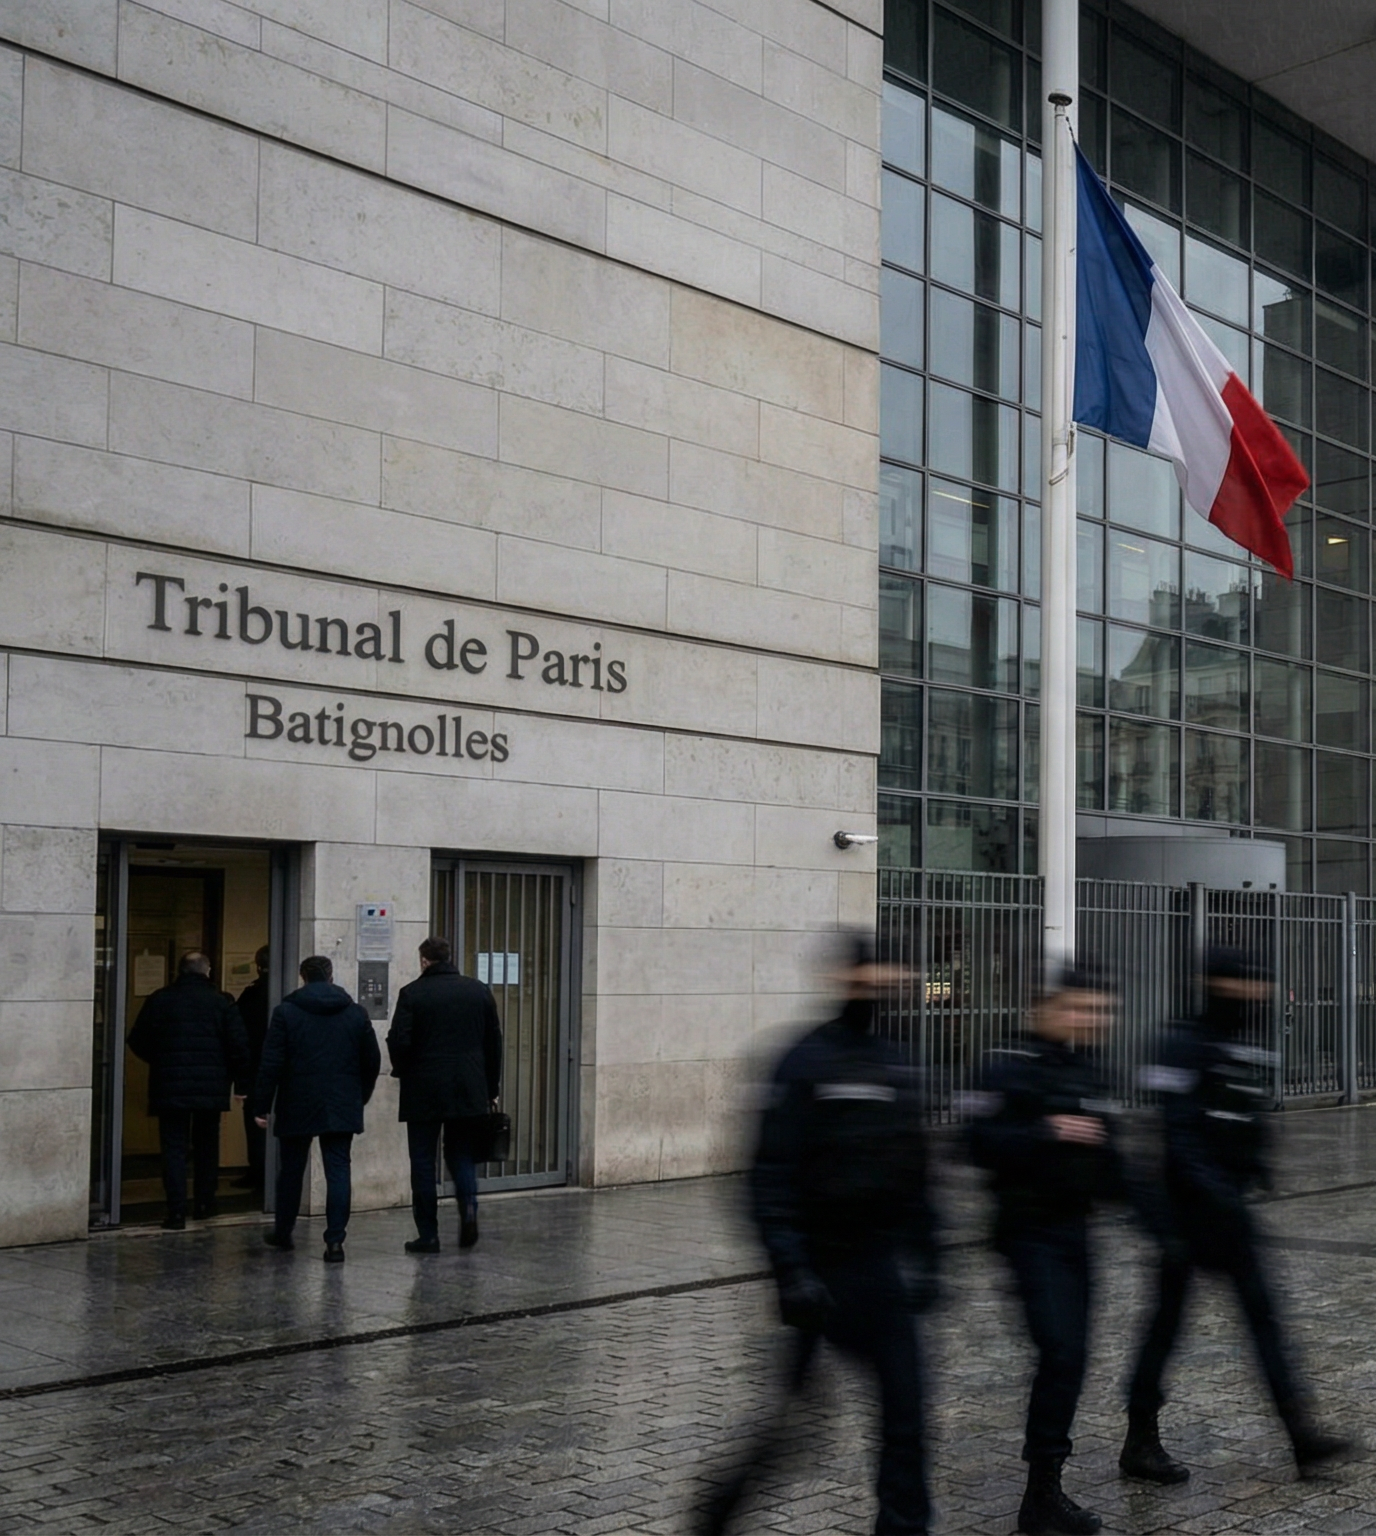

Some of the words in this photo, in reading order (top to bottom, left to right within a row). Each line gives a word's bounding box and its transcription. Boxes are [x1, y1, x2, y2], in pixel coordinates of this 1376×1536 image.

[135, 571, 405, 664] Tribunal
[424, 619, 488, 675] de
[505, 629, 629, 694] Paris
[244, 692, 510, 763] Batignolles
